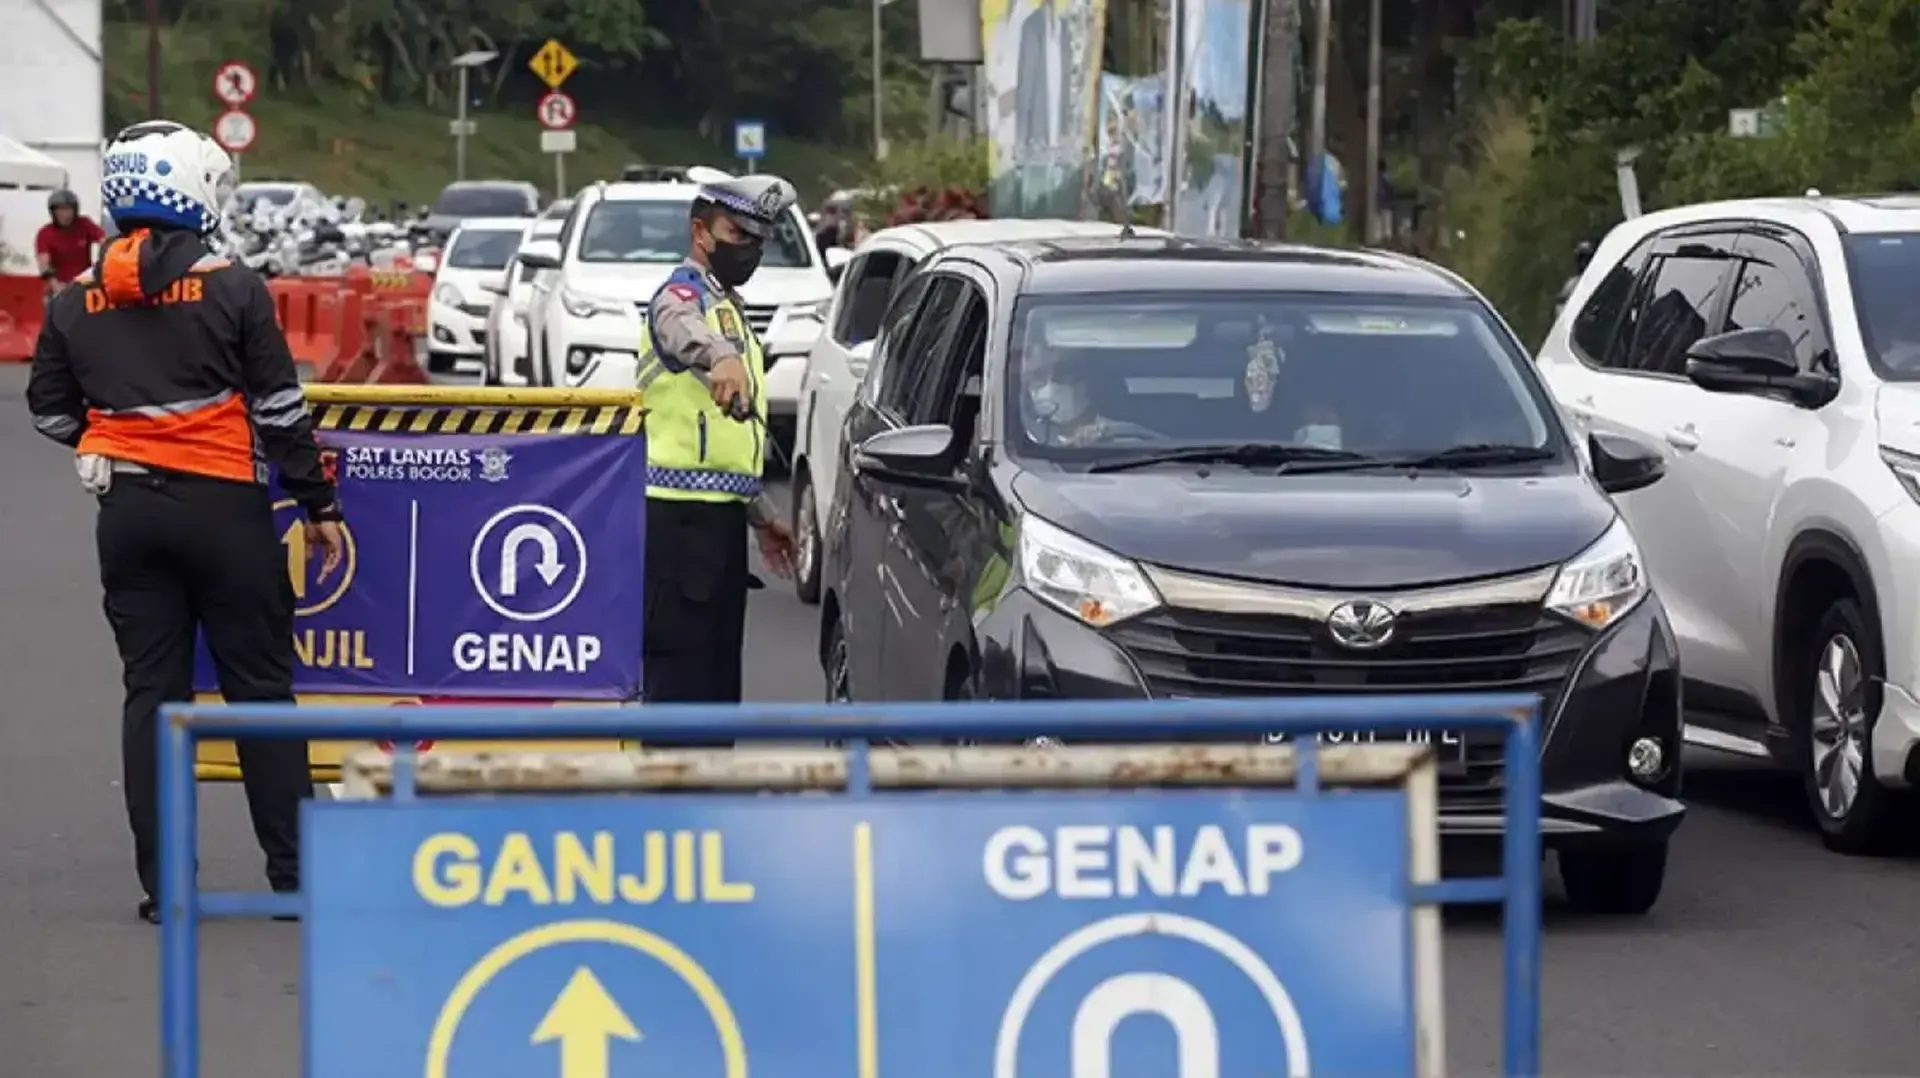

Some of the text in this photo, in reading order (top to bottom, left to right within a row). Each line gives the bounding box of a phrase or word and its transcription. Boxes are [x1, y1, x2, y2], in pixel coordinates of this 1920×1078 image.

[85, 278, 203, 313] DUB
[346, 447, 471, 465] SAT LANTAS
[346, 464, 471, 481] POLRES BOGOR
[293, 629, 374, 669] NJIL
[452, 632, 601, 673] GENAP
[412, 830, 755, 907] GANJIL
[983, 824, 1303, 899] GENAP
